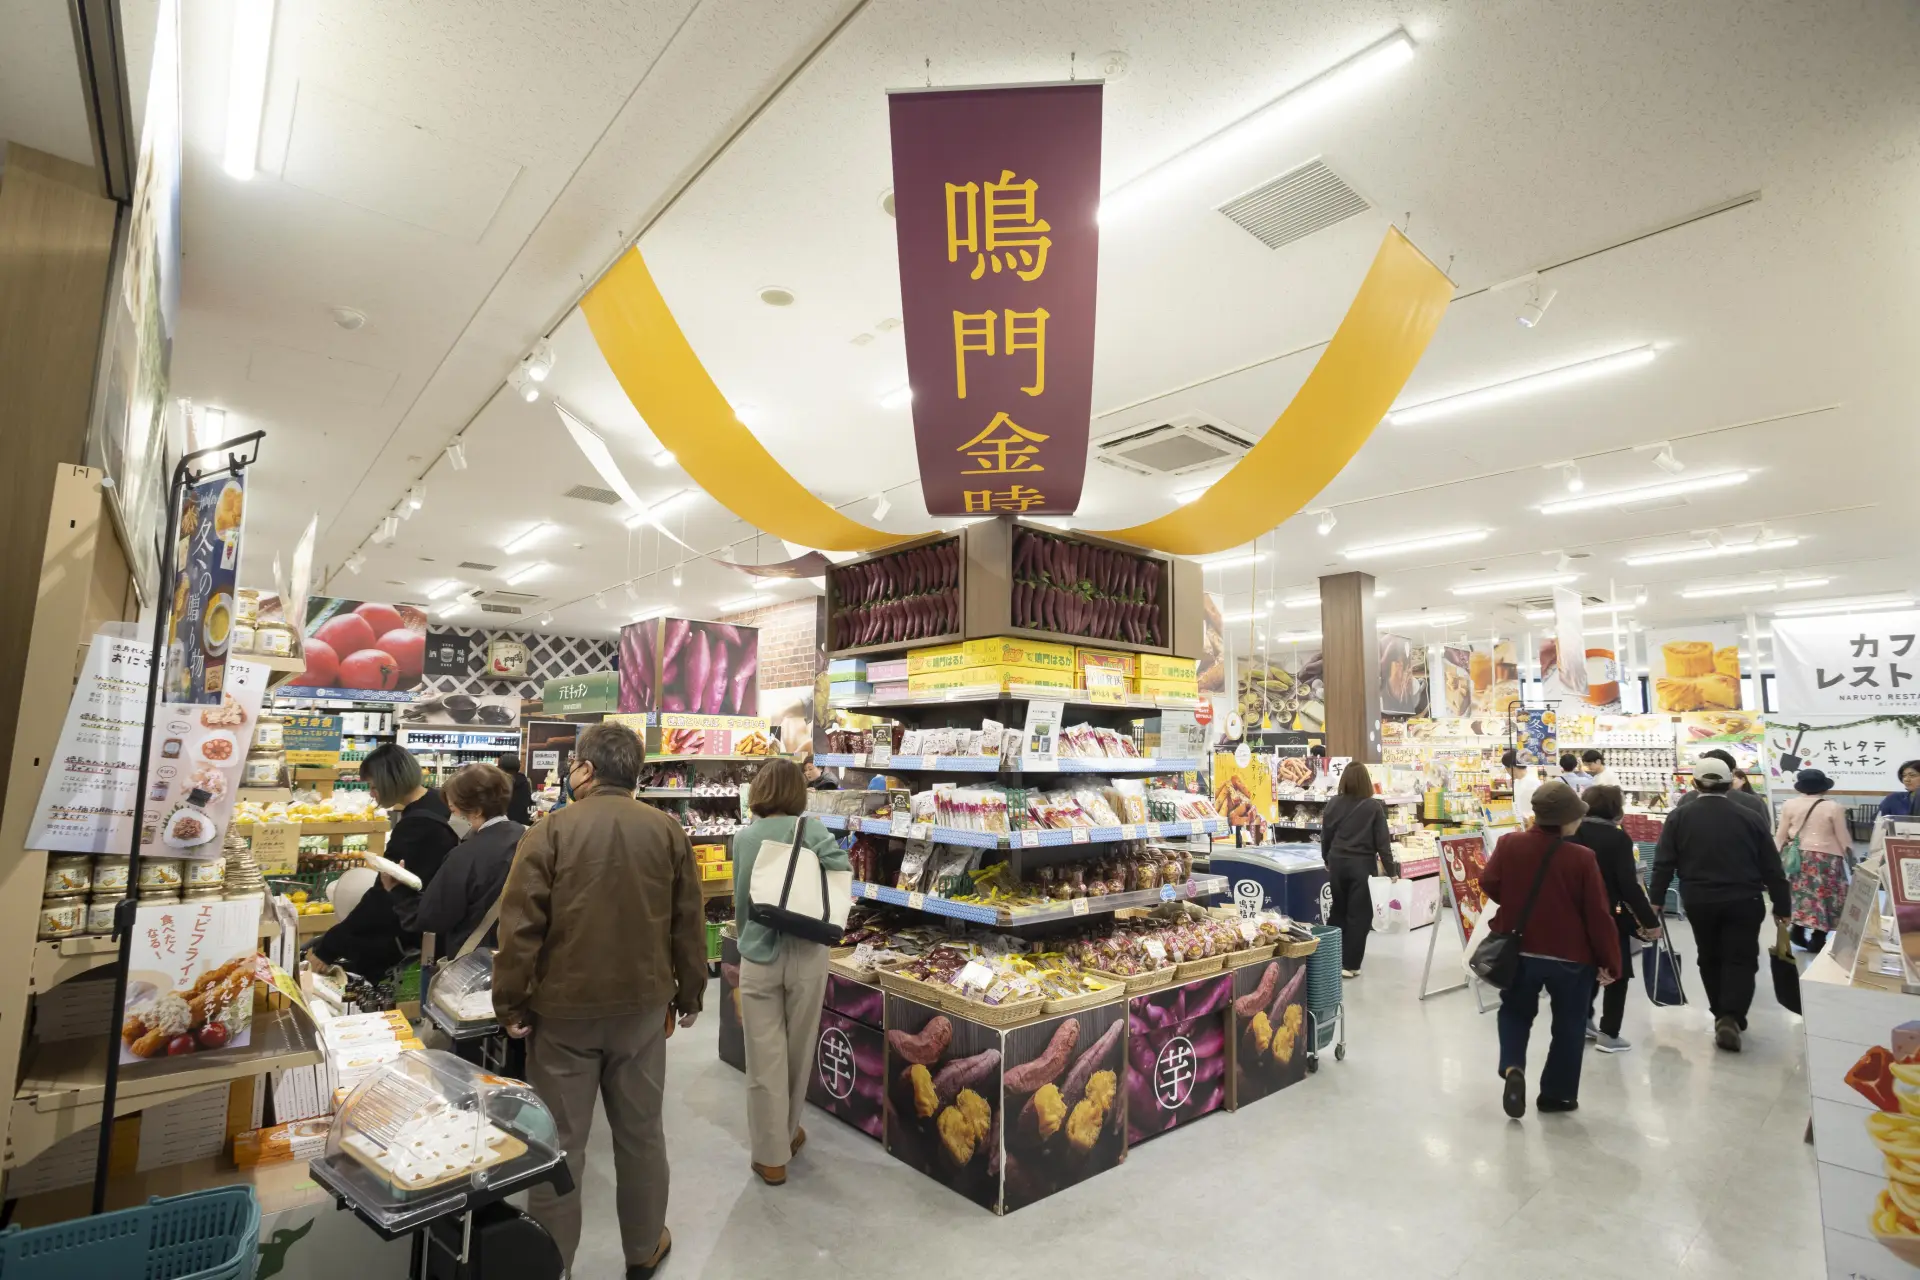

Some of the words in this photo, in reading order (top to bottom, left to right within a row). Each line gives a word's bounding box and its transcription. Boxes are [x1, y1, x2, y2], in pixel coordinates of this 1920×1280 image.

[944, 169, 1053, 513] 鳴門金時
[1034, 651, 1073, 667] 鳴門はるか
[1091, 672, 1122, 686] 発送
[1815, 662, 1914, 690] レスト
[558, 683, 589, 700] デモキッチン
[1838, 693, 1882, 701] NARUTO
[1823, 740, 1887, 752] ホレタテ
[1827, 754, 1887, 767] キッチン
[160, 913, 176, 954] 食べたく
[178, 905, 213, 986] エビフライが
[201, 980, 217, 1033] タルタルソース
[823, 1036, 852, 1090] 芋
[1161, 1046, 1193, 1101] 芋
